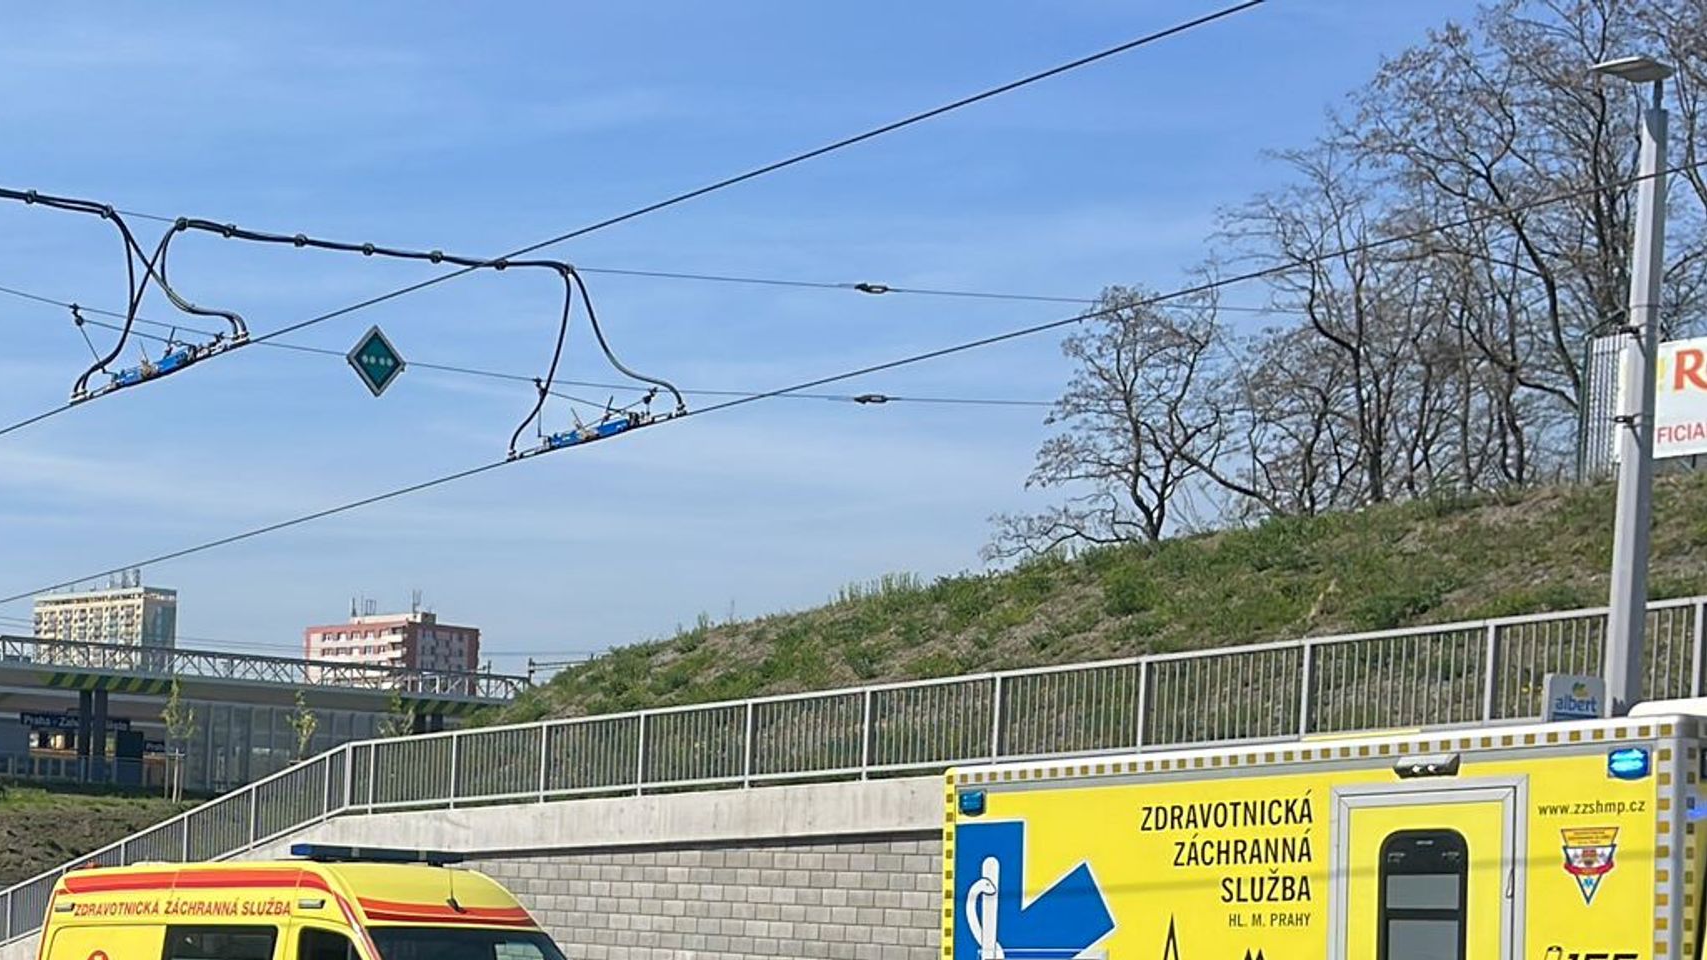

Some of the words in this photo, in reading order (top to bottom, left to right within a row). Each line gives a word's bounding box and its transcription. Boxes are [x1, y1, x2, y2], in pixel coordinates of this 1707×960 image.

[1674, 348, 1707, 391] R
[1655, 423, 1707, 444] FICIA
[1555, 694, 1598, 712] albert
[1140, 789, 1313, 831] ZDRAVOTNICKÁ
[1537, 800, 1646, 816] www.zzshmp.cz
[1173, 828, 1312, 867] ZÁCHRANNÁ
[1221, 867, 1311, 903] SLUŽBA
[74, 898, 159, 917] ZDRAVOTNICKÁ
[164, 897, 238, 917] ZÁCHRANNÁ
[241, 897, 291, 917] SLUŽBA
[1229, 914, 1247, 928] HL.
[1251, 914, 1266, 928] M.
[1270, 912, 1311, 928] PRAHY
